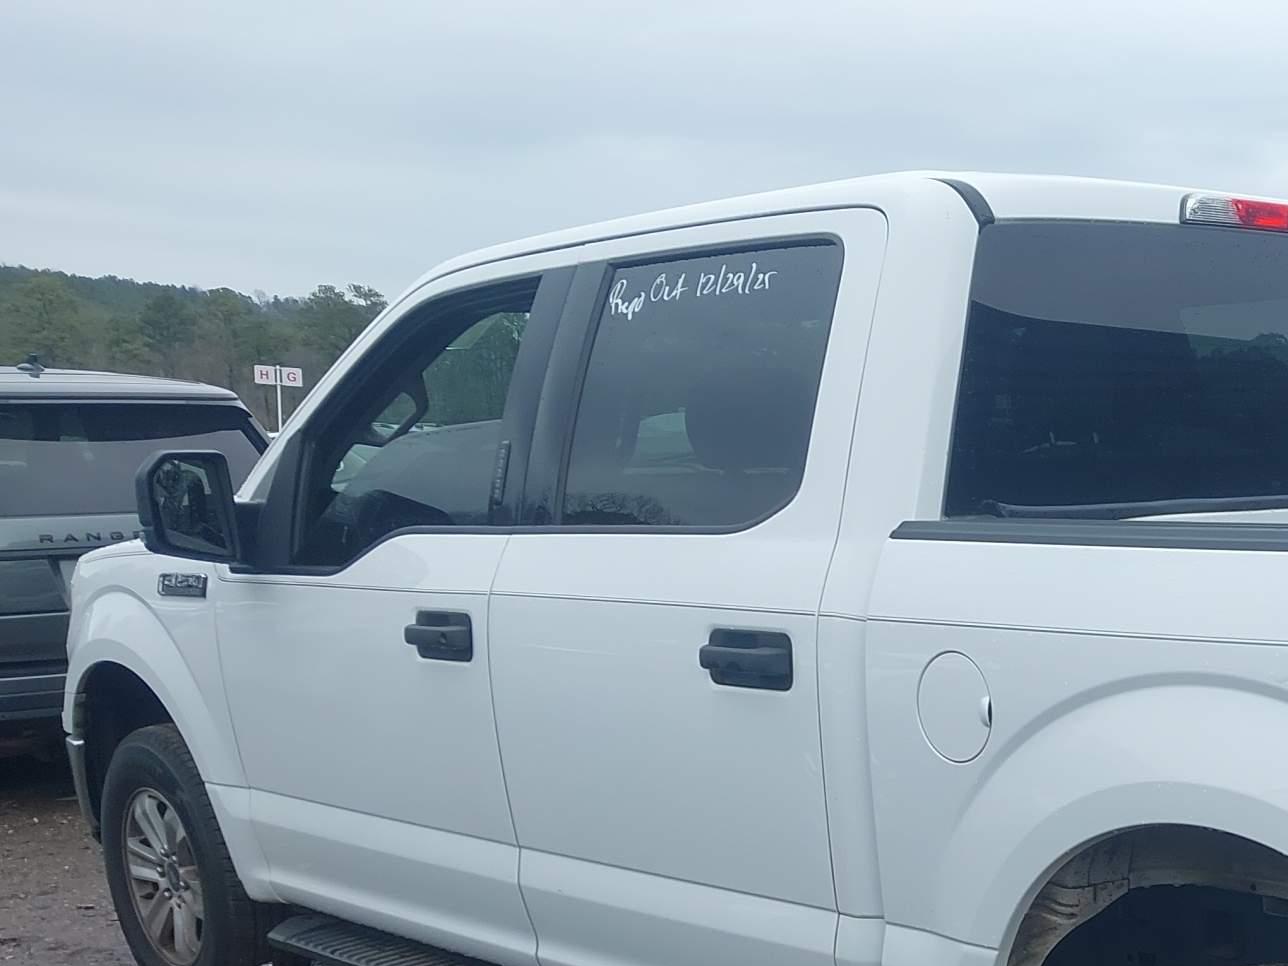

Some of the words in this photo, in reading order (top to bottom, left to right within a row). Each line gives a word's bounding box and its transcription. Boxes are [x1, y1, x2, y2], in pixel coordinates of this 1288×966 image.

[650, 272, 689, 302] Out
[260, 370, 269, 380] H
[287, 372, 297, 382] G
